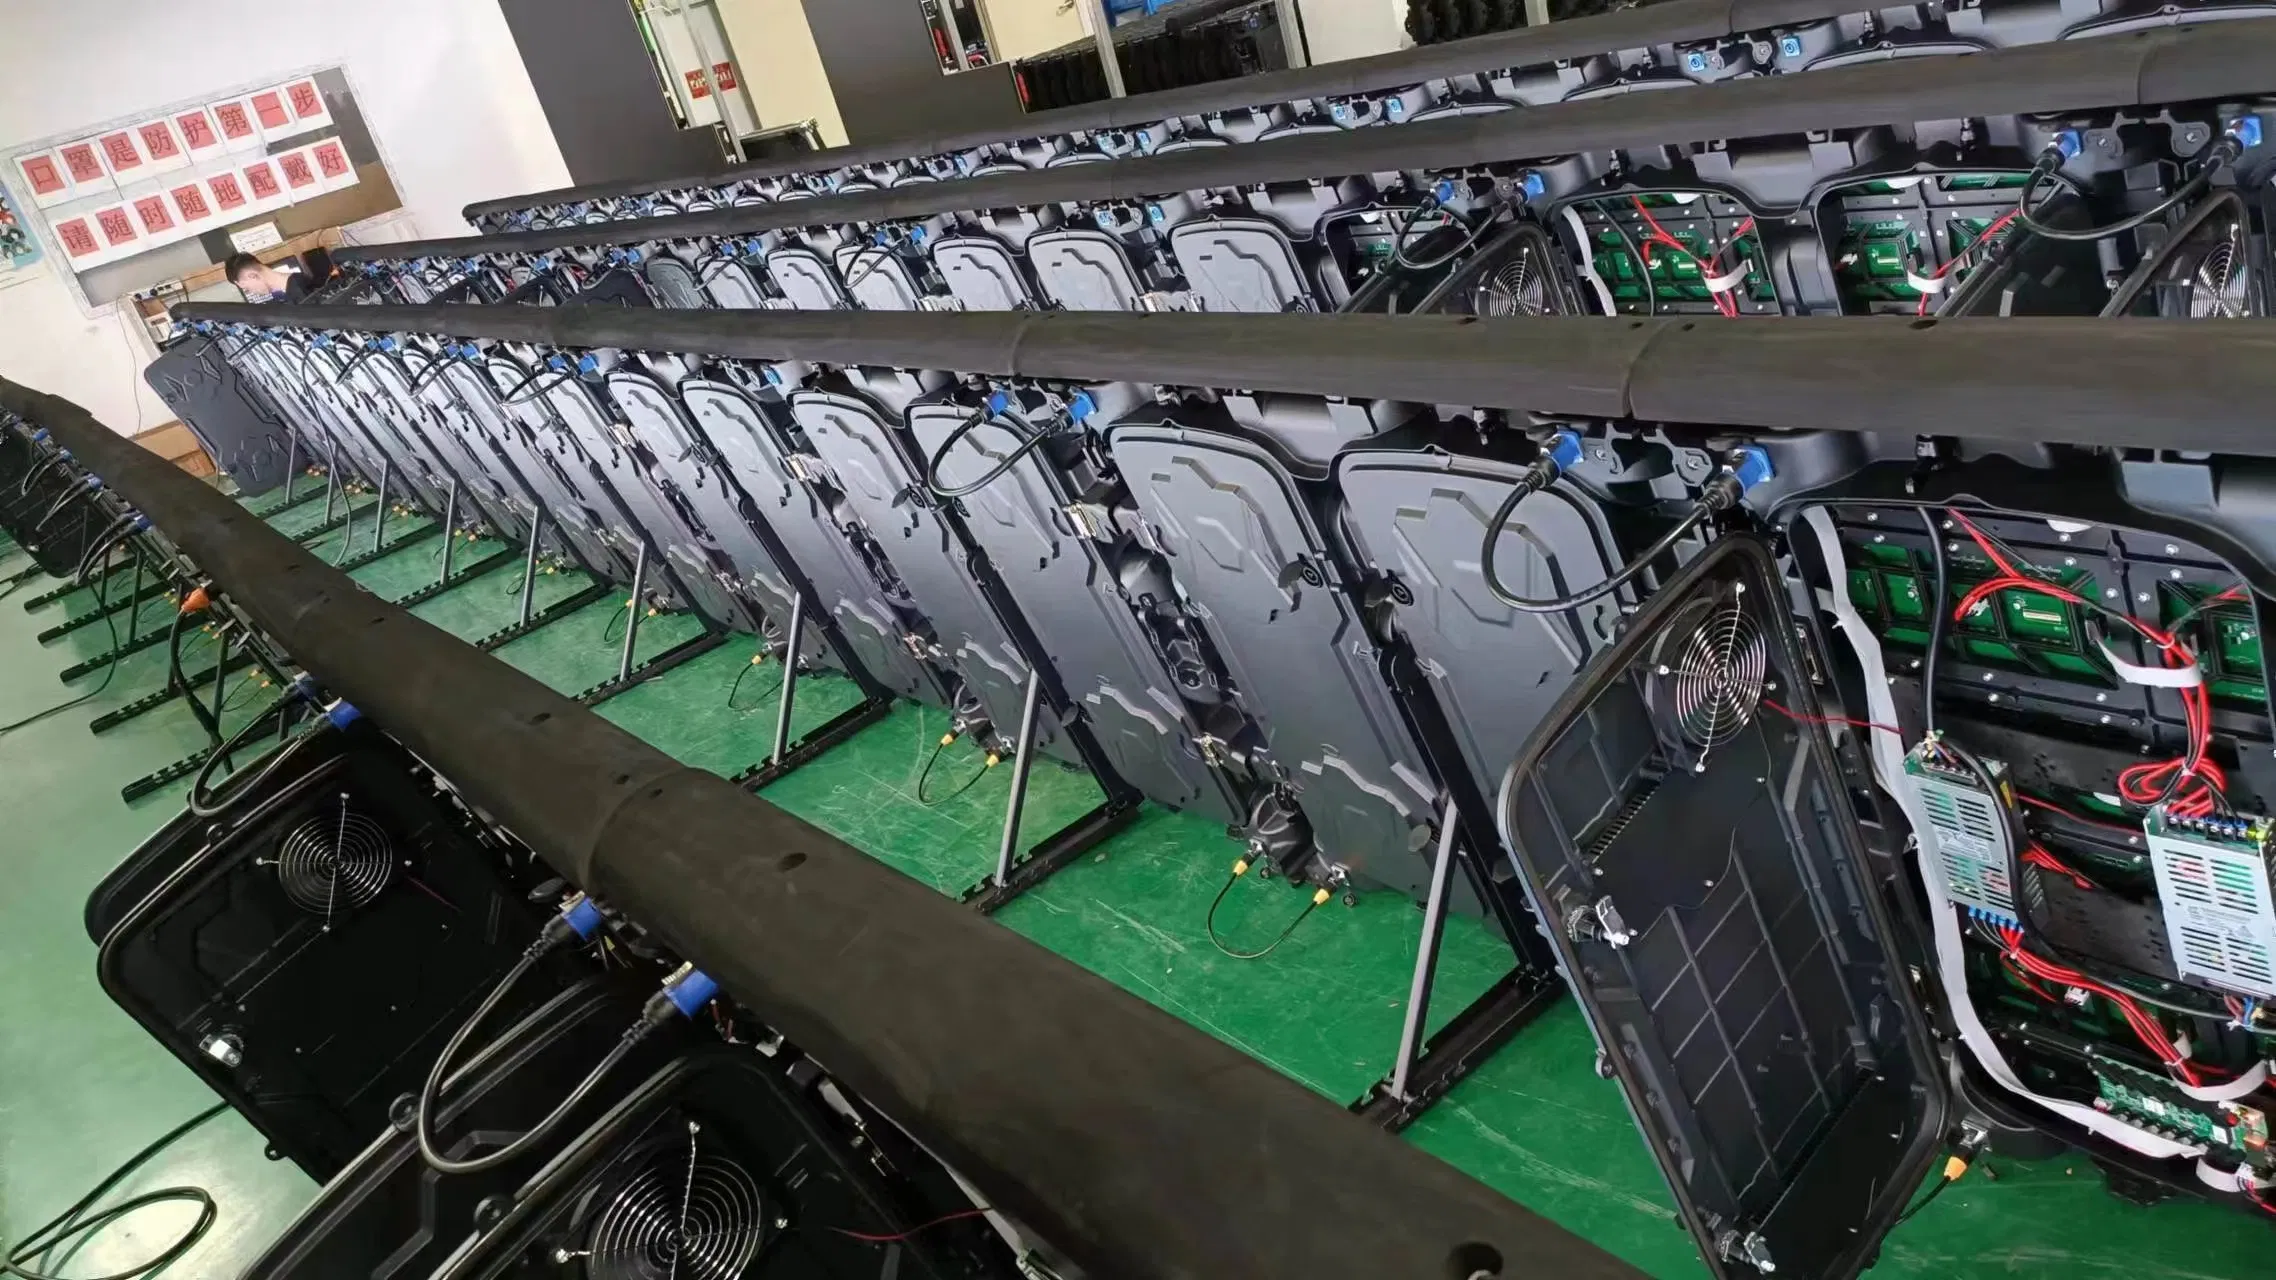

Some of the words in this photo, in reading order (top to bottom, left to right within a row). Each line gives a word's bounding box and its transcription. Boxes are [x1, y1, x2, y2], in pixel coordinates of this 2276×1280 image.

[31, 88, 314, 187] 口罩是防护第一步
[62, 147, 340, 250] 请随时随地配戴好
